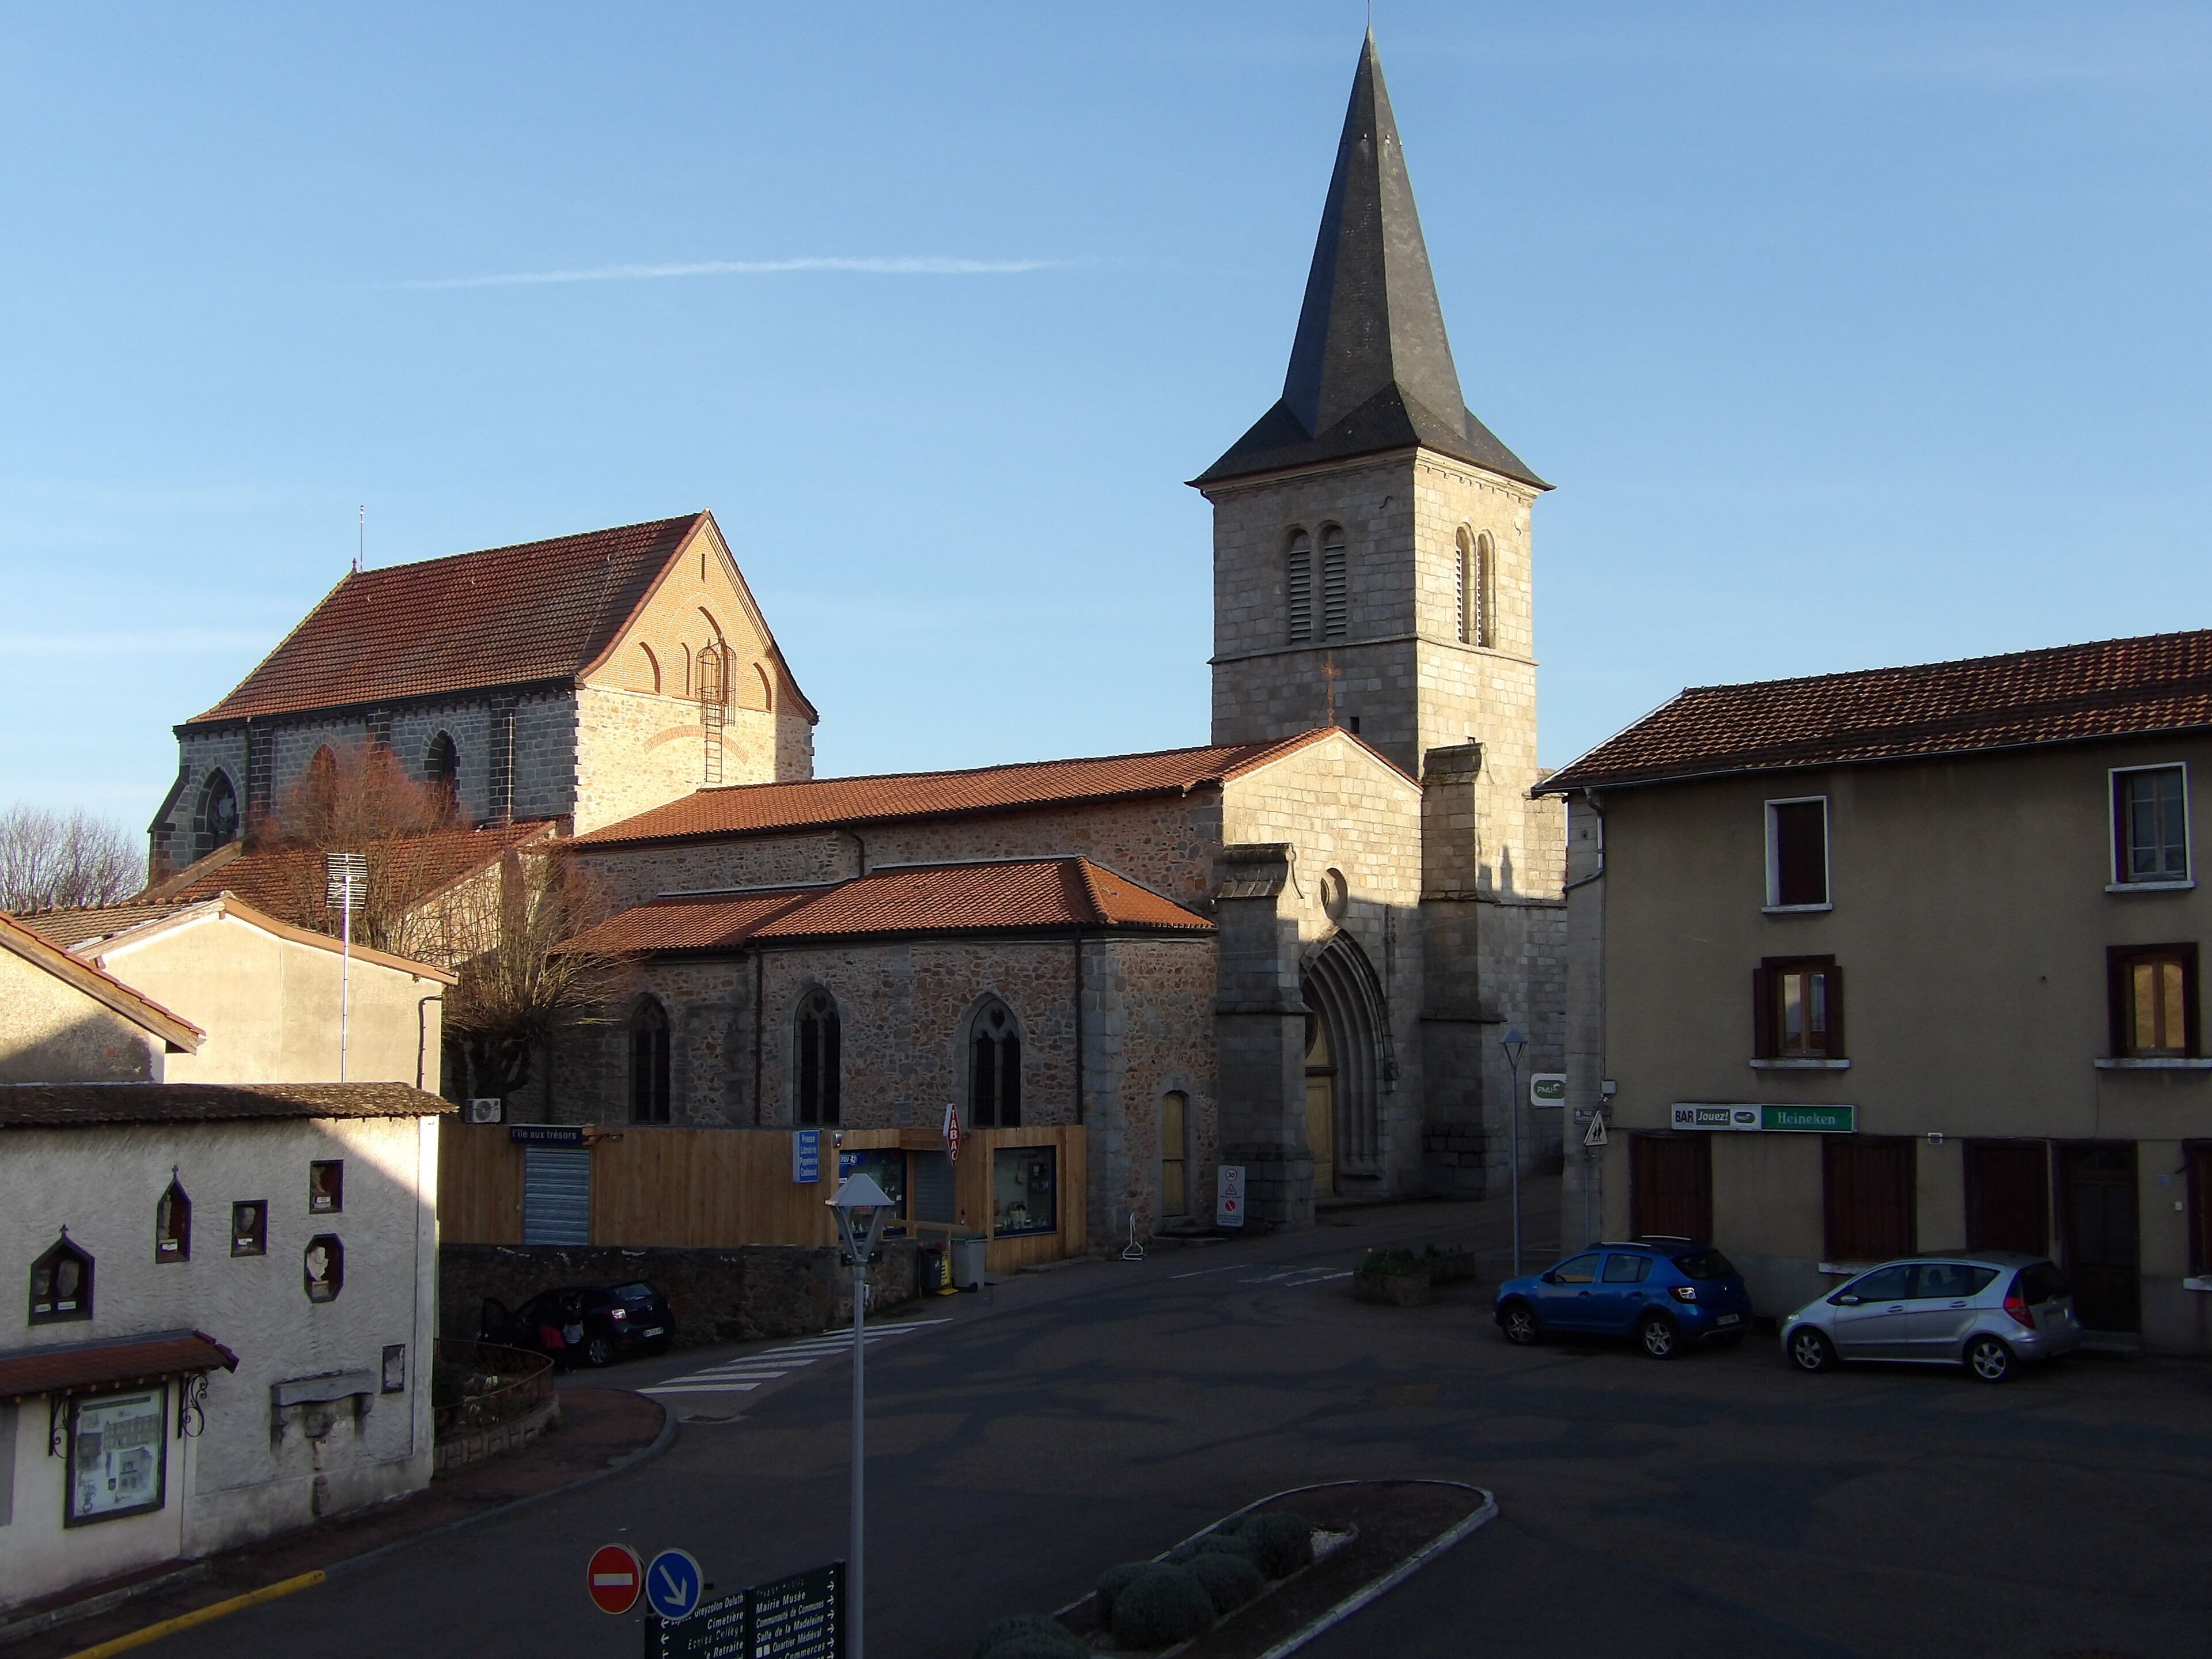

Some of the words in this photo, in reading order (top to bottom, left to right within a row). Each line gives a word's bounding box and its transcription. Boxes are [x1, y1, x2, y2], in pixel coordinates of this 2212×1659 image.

[1675, 1110, 1694, 1123] BAR
[1698, 1111, 1729, 1121] Jouez!
[1778, 1112, 1836, 1125] Heineken
[530, 1131, 544, 1139] aux
[547, 1130, 577, 1140] trésors
[725, 1593, 744, 1609] Duluth
[756, 1599, 780, 1615] Mairie
[782, 1590, 806, 1606] Musée
[707, 1611, 744, 1630] Cimetière
[756, 1609, 789, 1629] Communauté
[790, 1607, 797, 1618] de
[798, 1600, 824, 1615] Communes
[716, 1625, 744, 1641] Collège
[756, 1630, 772, 1644] Salle
[775, 1627, 783, 1638] de
[785, 1624, 791, 1634] la
[793, 1614, 824, 1632] Madeleine
[772, 1637, 796, 1653] Quartier
[797, 1627, 822, 1645] Médiéval
[713, 1641, 744, 1658] Retraite
[785, 1642, 825, 1659] Commerces
